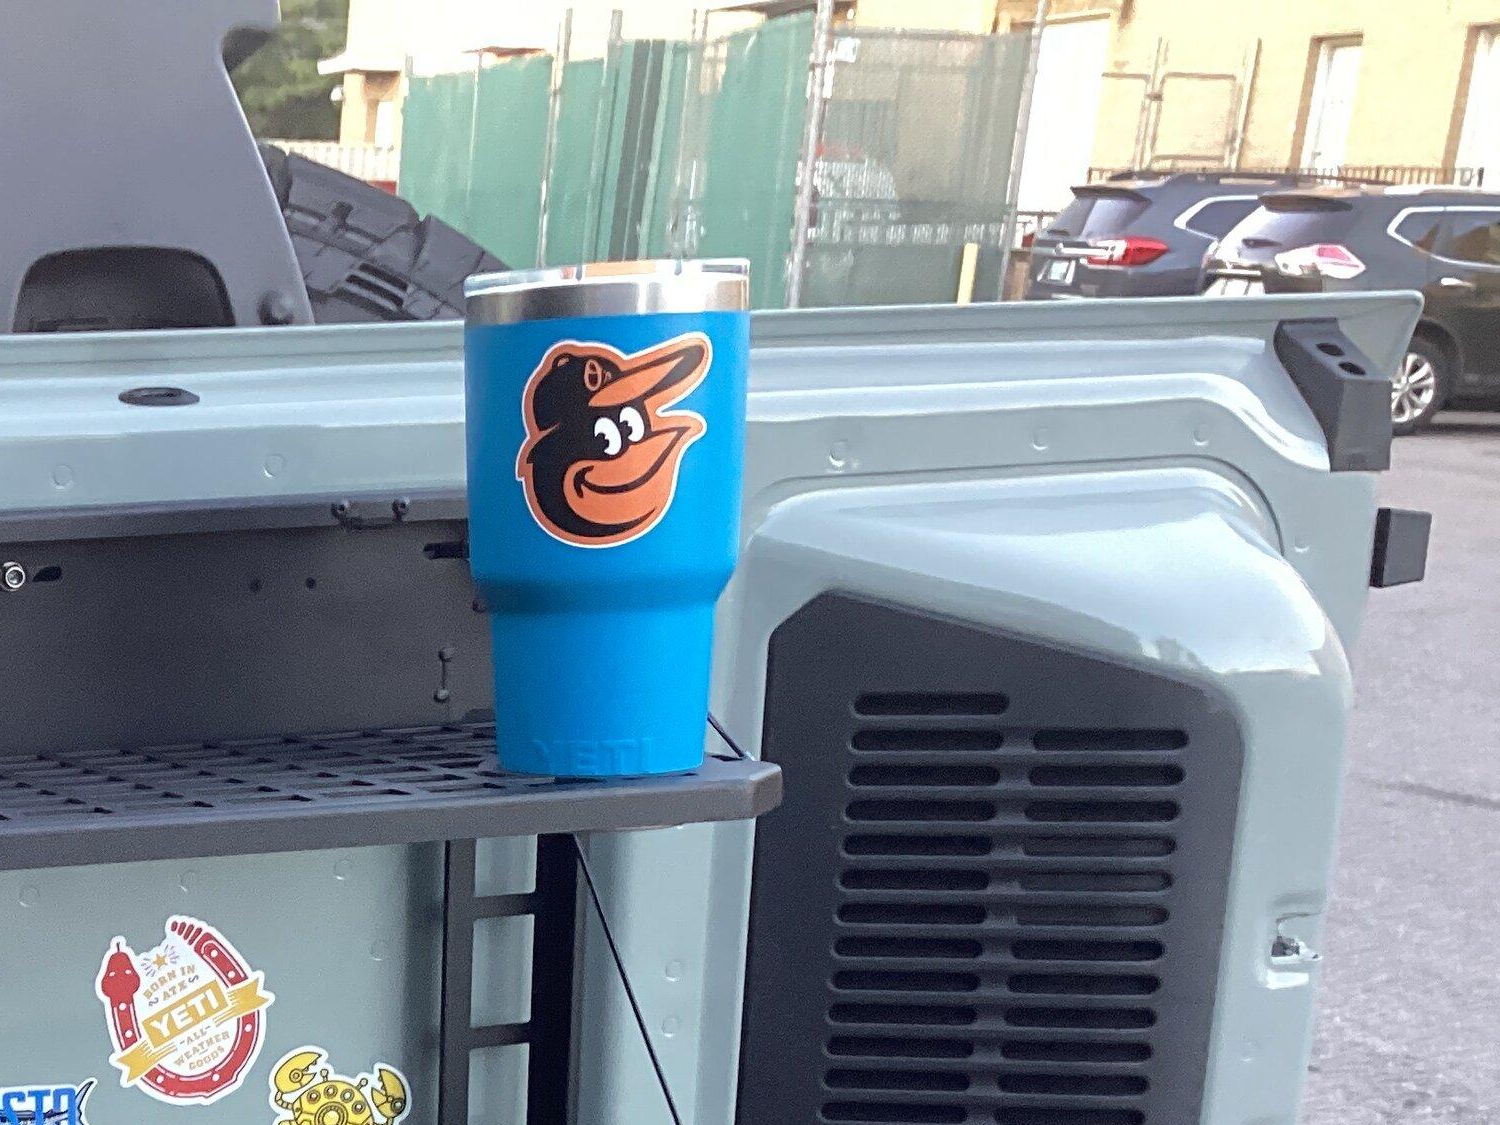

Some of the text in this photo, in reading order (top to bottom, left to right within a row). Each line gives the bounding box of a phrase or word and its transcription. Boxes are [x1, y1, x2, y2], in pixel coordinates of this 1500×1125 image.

[530, 737, 654, 774] YETI
[143, 964, 195, 1000] BORN IN
[149, 988, 220, 1038] YETI
[174, 1031, 230, 1066] WEATHER
[188, 1046, 225, 1070] GOODS
